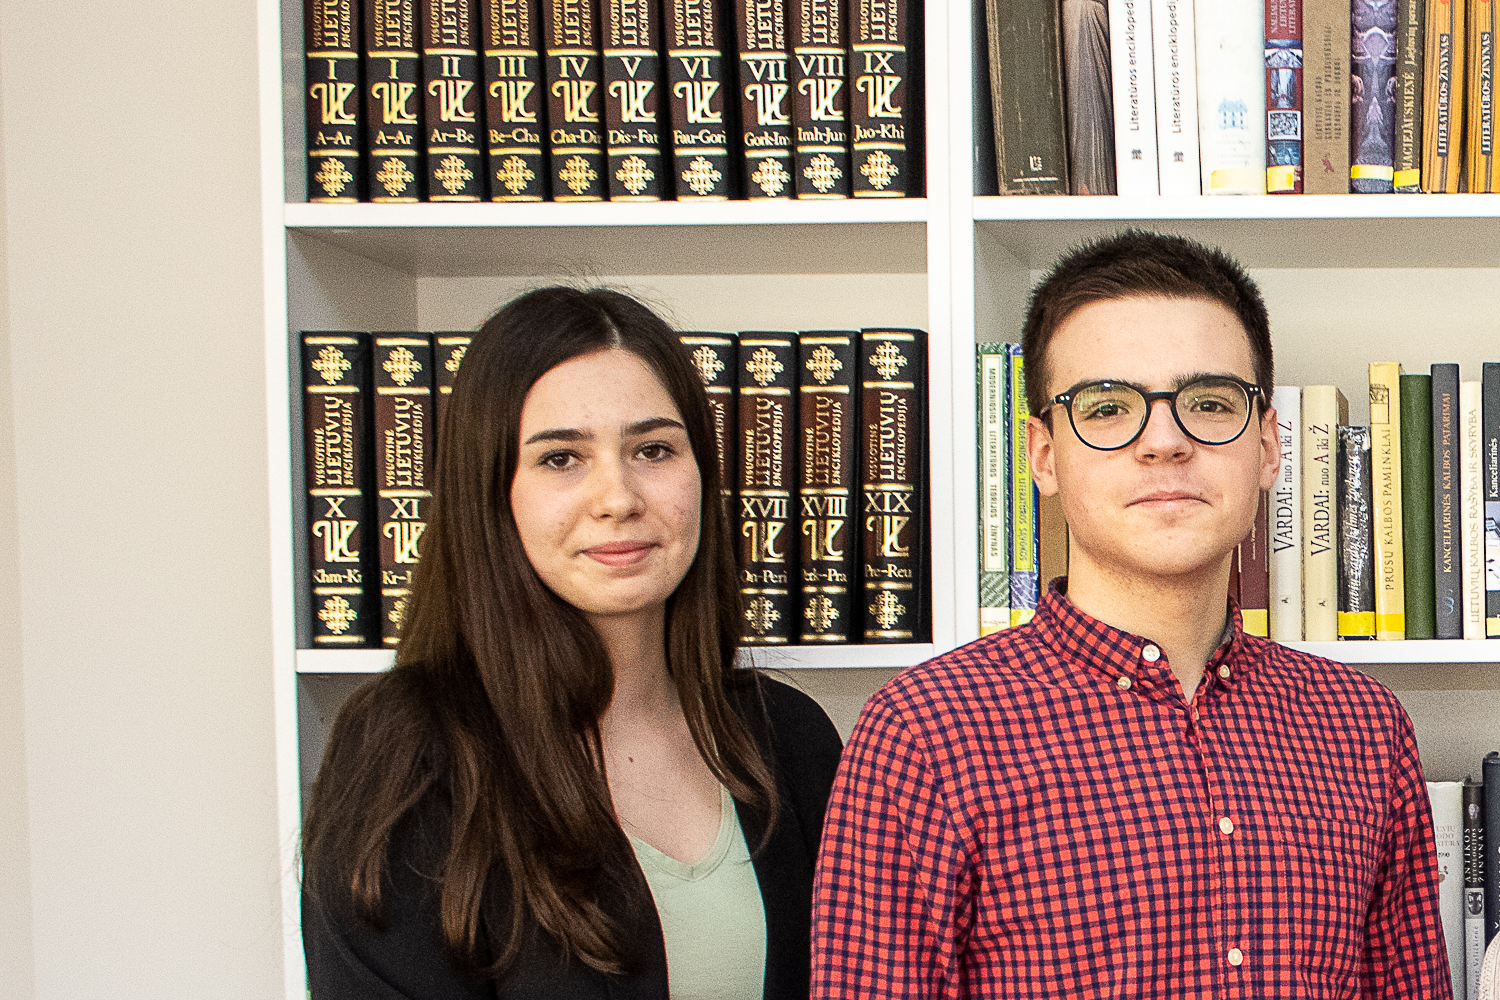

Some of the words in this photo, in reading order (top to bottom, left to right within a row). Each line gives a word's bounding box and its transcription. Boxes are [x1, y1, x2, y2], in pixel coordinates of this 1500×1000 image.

[441, 56, 461, 77] II
[498, 57, 527, 77] III
[558, 57, 589, 77] IV
[796, 55, 845, 77] VIII
[863, 52, 894, 73] IX
[1439, 34, 1450, 80] ŽINYNAS
[1481, 33, 1491, 79] ŽINYNAS
[620, 57, 642, 78] V
[680, 57, 711, 78] VI
[746, 60, 788, 82] VII
[1438, 83, 1449, 153] LITERATŪROS
[1481, 80, 1491, 152] LITERATŪROS
[1308, 424, 1328, 434] Ž
[1442, 392, 1451, 446] PATARIMAI
[324, 395, 343, 486] LIETUVIŲ
[343, 402, 354, 486] ENCIKLOPEDIJA
[395, 397, 414, 486] LIETUVIŲ
[1281, 436, 1292, 448] iki
[1468, 408, 1478, 458] SKYRYBA
[1314, 454, 1328, 464] A
[1381, 428, 1392, 496] PAMINKLAI
[1488, 438, 1498, 498] Kanceliarinės
[1283, 465, 1293, 483] nuo
[1320, 468, 1329, 486] nuo
[324, 497, 346, 518] X
[390, 498, 420, 518] XI
[741, 497, 788, 518] XVII
[801, 496, 848, 518] XVIII
[864, 491, 913, 512] XIX
[1466, 476, 1478, 518] RAŠYBA
[1273, 486, 1294, 553] VARDAI:
[1310, 490, 1332, 556] VARDAI:
[1383, 500, 1394, 545] KALBOS
[1442, 494, 1452, 572] KANCELIARINĖS
[1464, 828, 1472, 882] ANTIKOS
